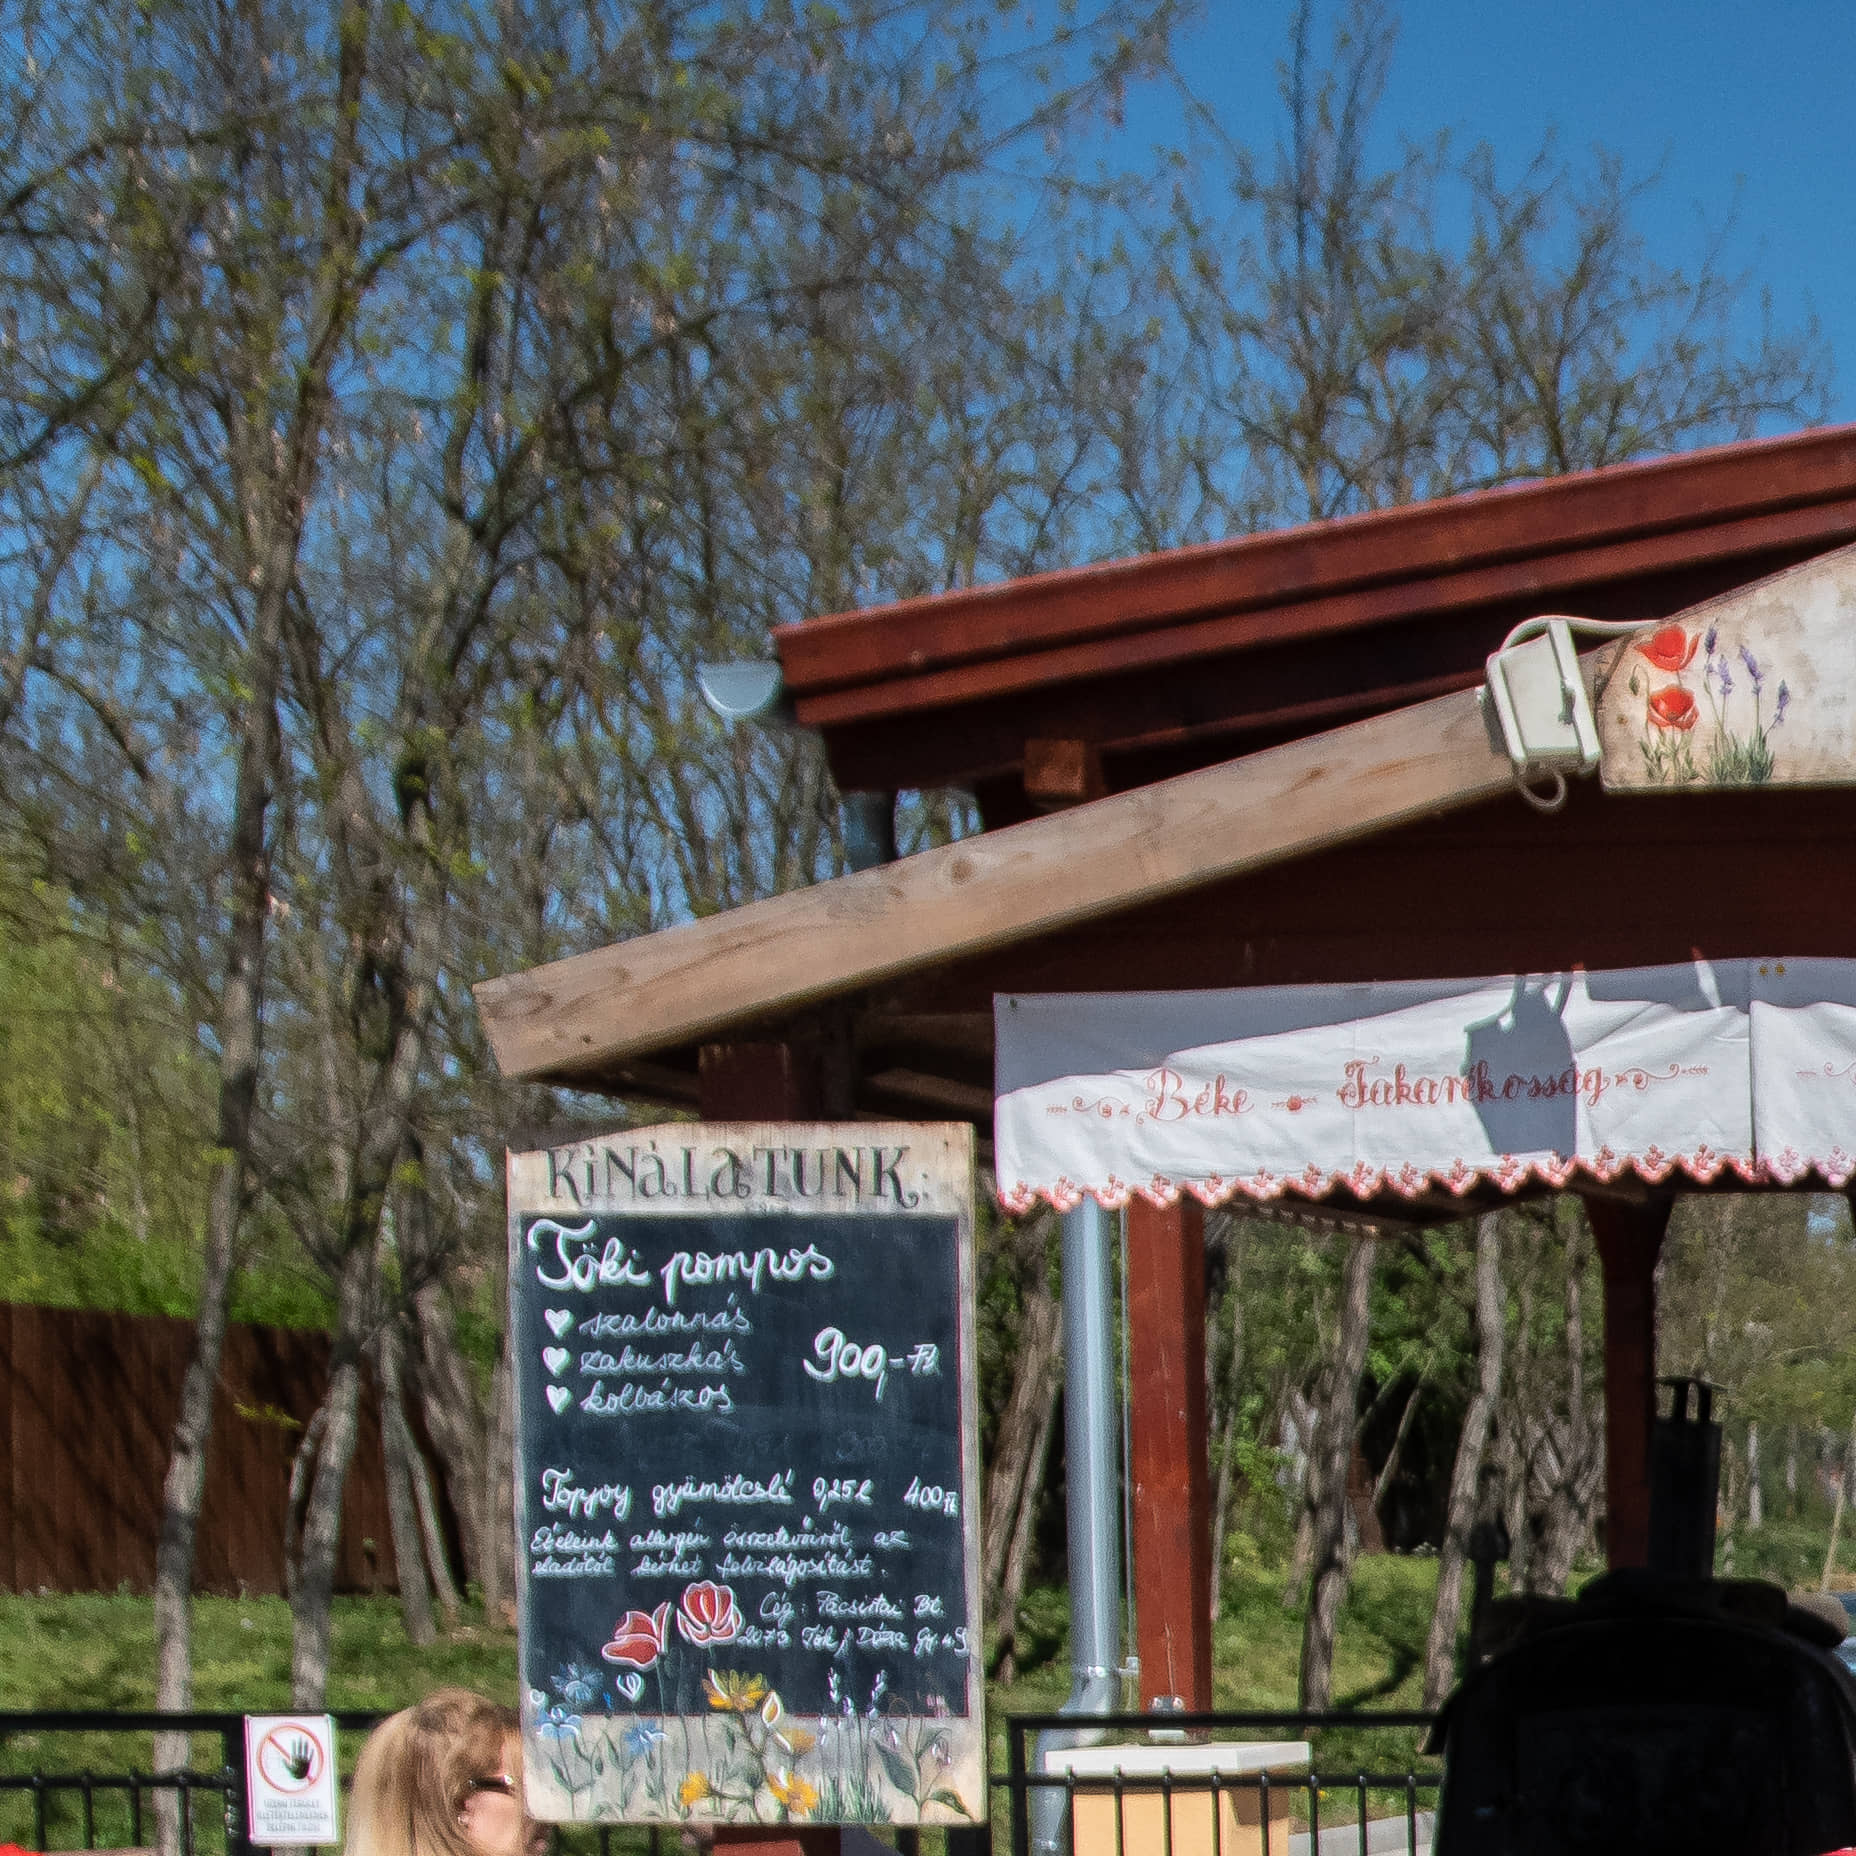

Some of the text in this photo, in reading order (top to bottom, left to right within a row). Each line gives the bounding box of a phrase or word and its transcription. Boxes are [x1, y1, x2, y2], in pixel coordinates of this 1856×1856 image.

[1136, 1067, 1256, 1124] Béke
[527, 1217, 836, 1306] Töki pompos
